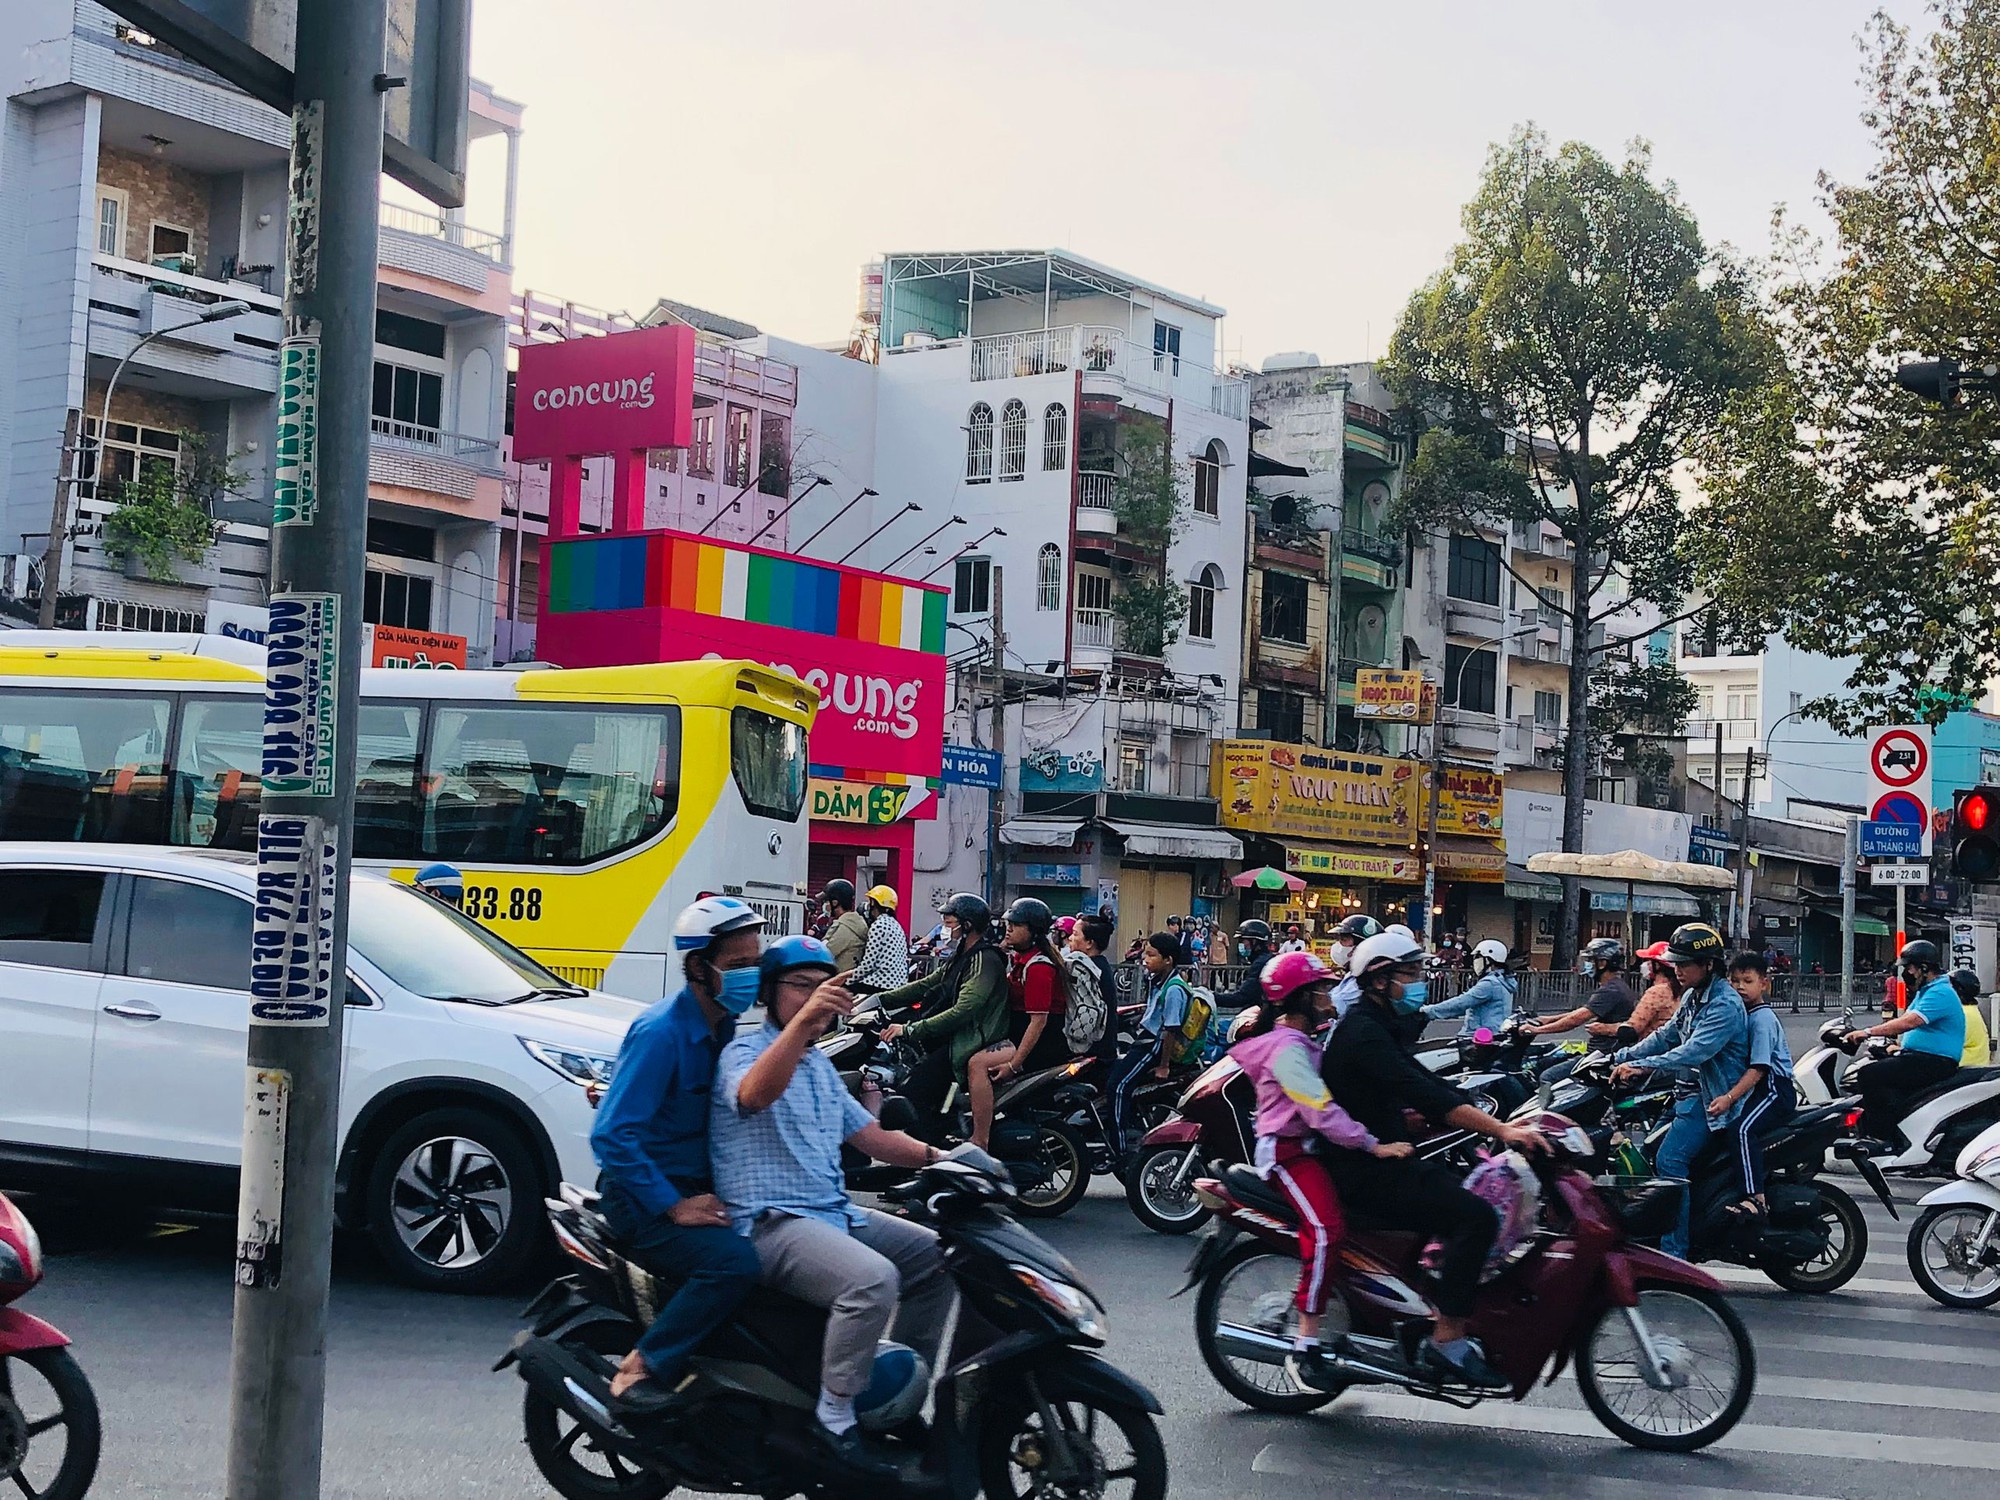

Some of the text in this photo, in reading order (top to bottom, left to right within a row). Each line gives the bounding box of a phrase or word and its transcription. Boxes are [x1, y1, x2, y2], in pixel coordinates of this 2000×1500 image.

[533, 371, 657, 411] concung
[1361, 686, 1388, 702] NGỌC
[852, 716, 890, 735] .com
[957, 759, 989, 775] HÓA
[1289, 775, 1338, 806] NGỌC
[813, 786, 864, 819] DẶM
[1874, 824, 1910, 836] ĐƯỜNG
[1863, 841, 1875, 852] BA
[1876, 838, 1904, 852] THÁNG
[457, 886, 543, 922] 33.88
